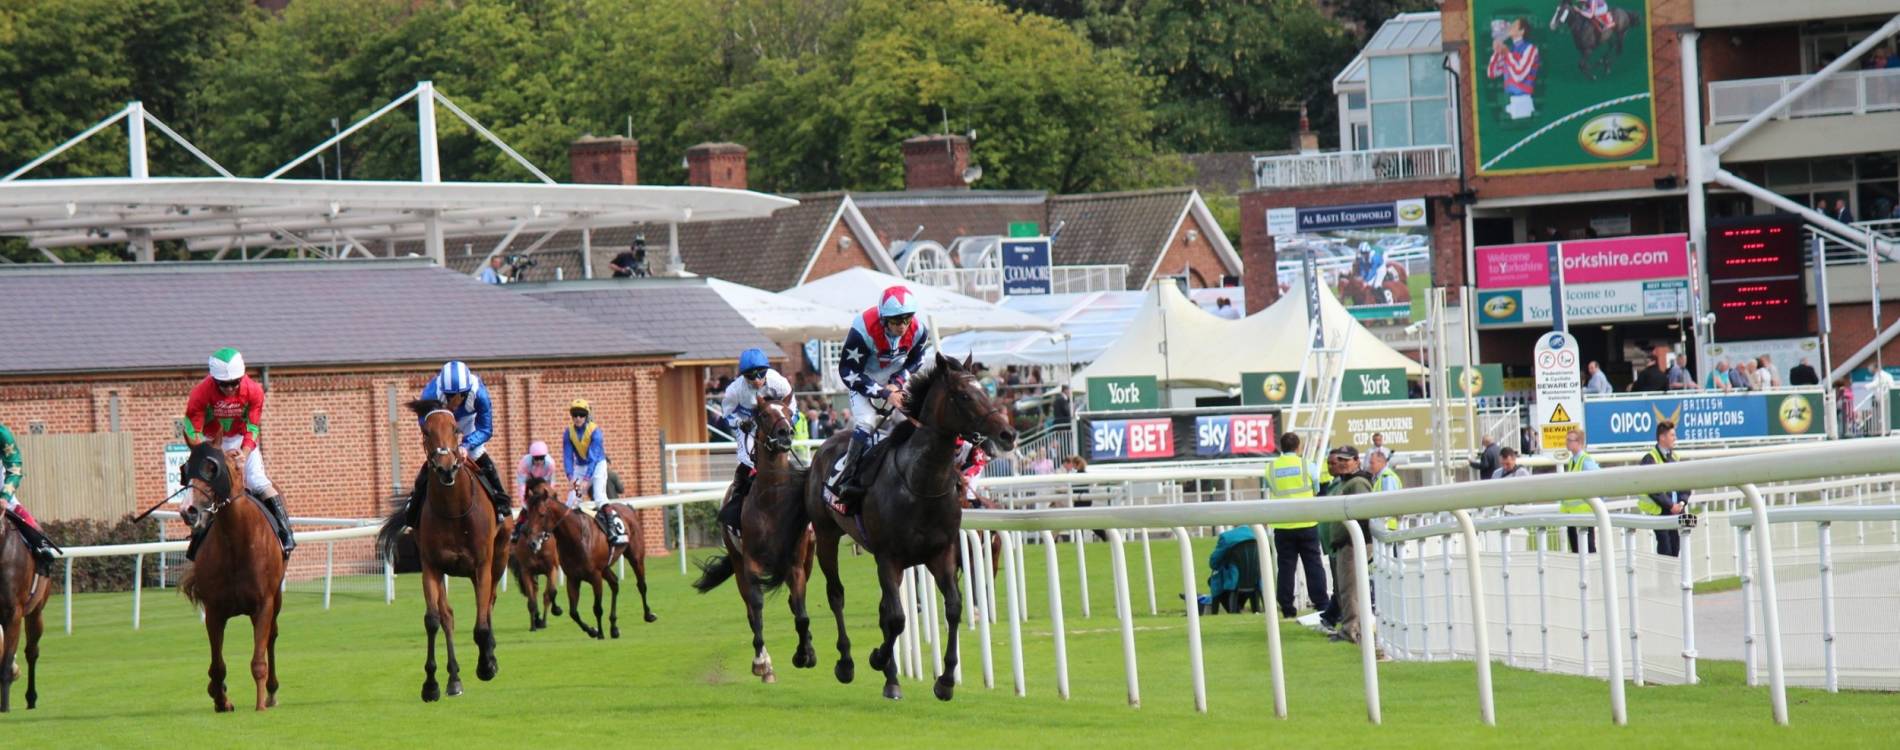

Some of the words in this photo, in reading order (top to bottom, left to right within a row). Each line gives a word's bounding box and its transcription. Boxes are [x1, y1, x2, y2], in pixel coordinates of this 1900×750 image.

[1303, 214, 1314, 224] AL
[1316, 213, 1339, 223] BASTI
[1340, 210, 1392, 222] EQUIWORLD
[1488, 252, 1530, 262] Welcome
[1563, 250, 1668, 270] orkshire.com
[1004, 266, 1050, 283] COOLMORE
[1564, 290, 1600, 300] lcome
[1604, 289, 1616, 298] to
[1530, 306, 1550, 318] Yor
[1108, 382, 1140, 404] York
[1360, 374, 1391, 396] York
[1683, 398, 1723, 412] BRITISH
[1348, 418, 1364, 432] 2015
[1364, 416, 1413, 430] MELBOURNE
[1610, 412, 1651, 433] QIPCO
[1684, 410, 1744, 428] CHAMPIONS
[1094, 422, 1124, 457] sky
[1130, 424, 1168, 452] BET
[1200, 418, 1228, 451] sky
[1234, 420, 1270, 448] BET
[1353, 432, 1370, 446] CUP
[1684, 428, 1720, 440] SERIES
